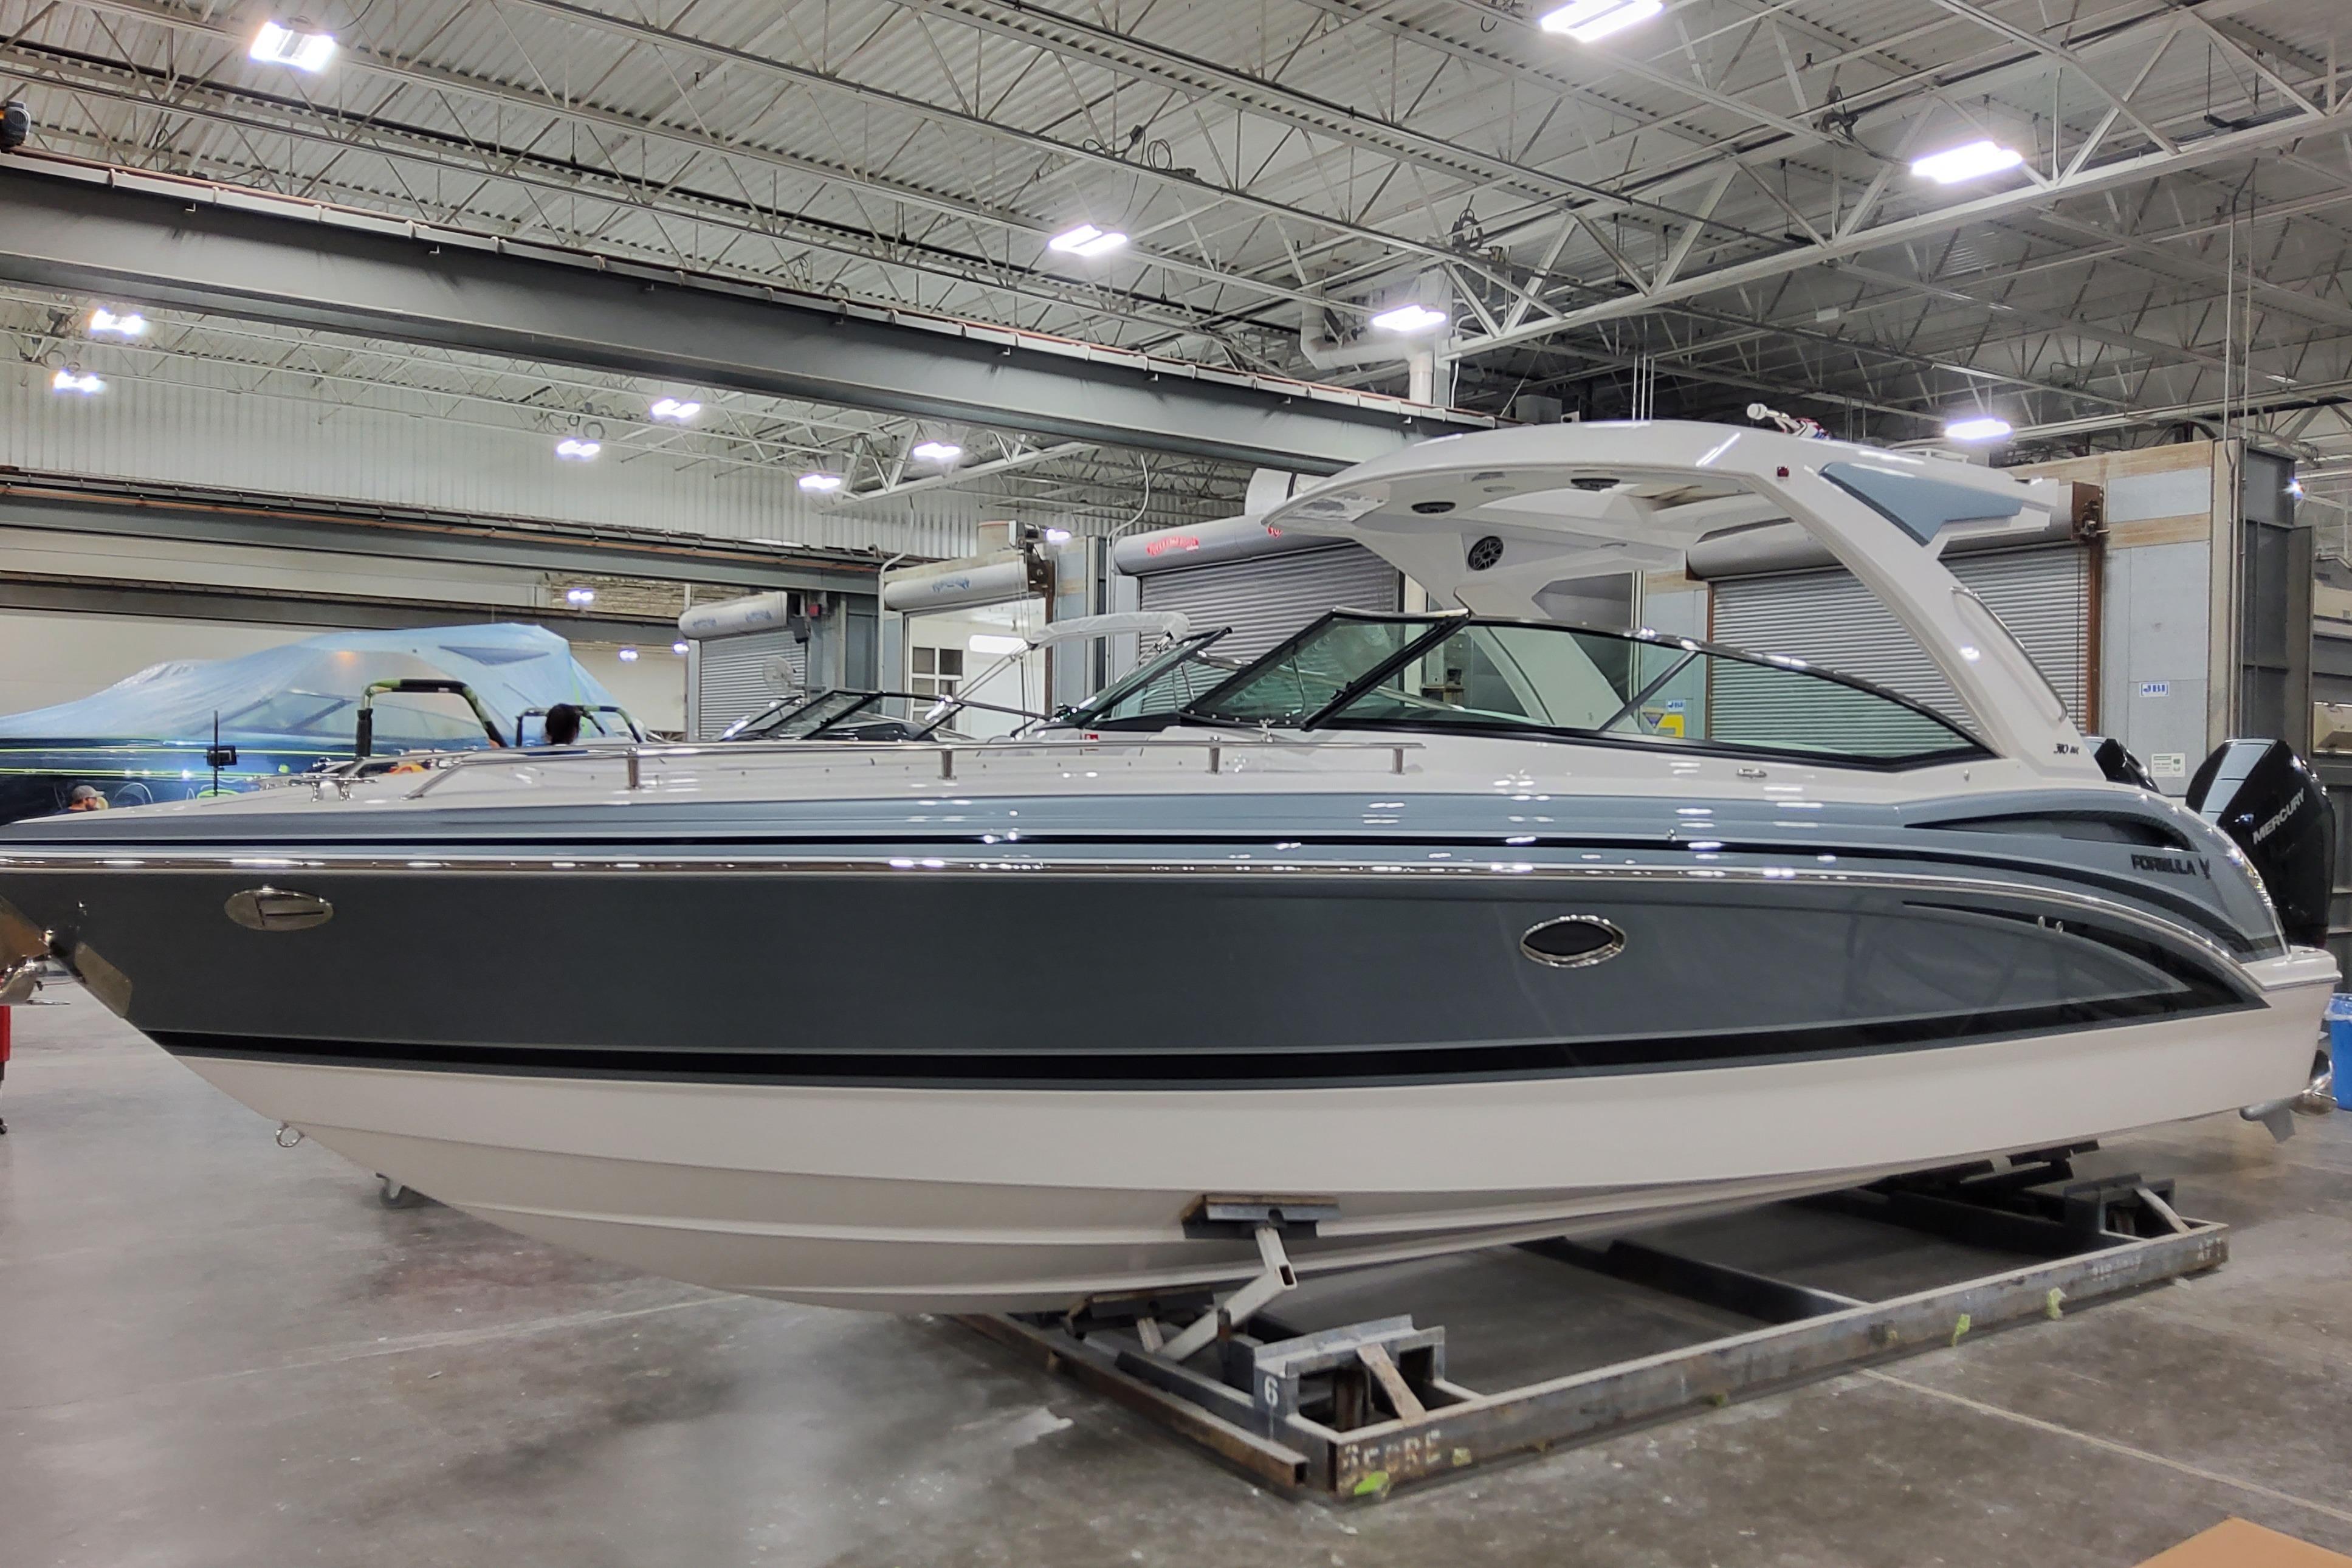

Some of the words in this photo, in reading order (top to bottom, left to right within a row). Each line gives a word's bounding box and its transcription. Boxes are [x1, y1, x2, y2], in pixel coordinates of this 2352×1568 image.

[2252, 787, 2304, 845] MERCURY
[2131, 854, 2196, 876] FORMULA
[1264, 1375, 1278, 1407] 6
